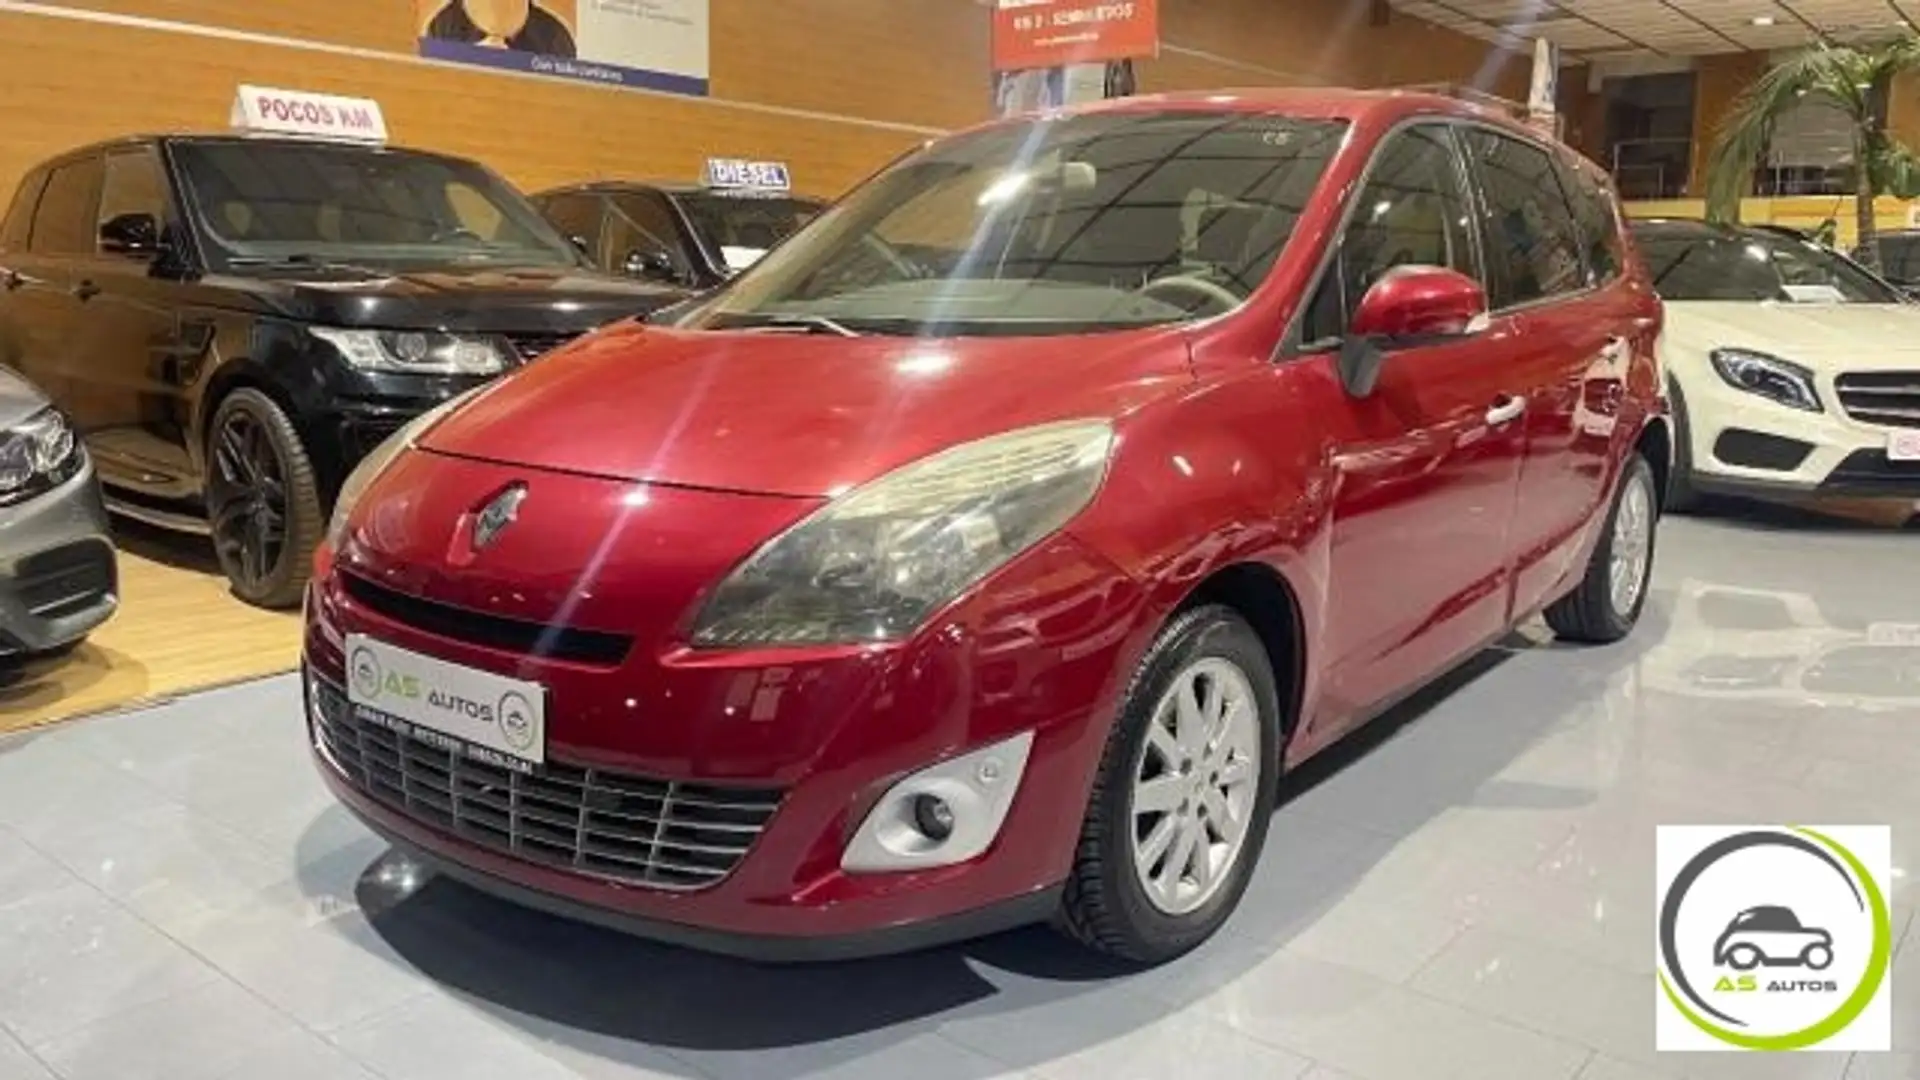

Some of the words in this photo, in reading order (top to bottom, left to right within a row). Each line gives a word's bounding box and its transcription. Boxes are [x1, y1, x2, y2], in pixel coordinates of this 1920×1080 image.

[257, 95, 334, 125] POCOS
[711, 163, 785, 186] DIESEL
[383, 670, 420, 698] AS
[428, 688, 495, 722] AUTOS
